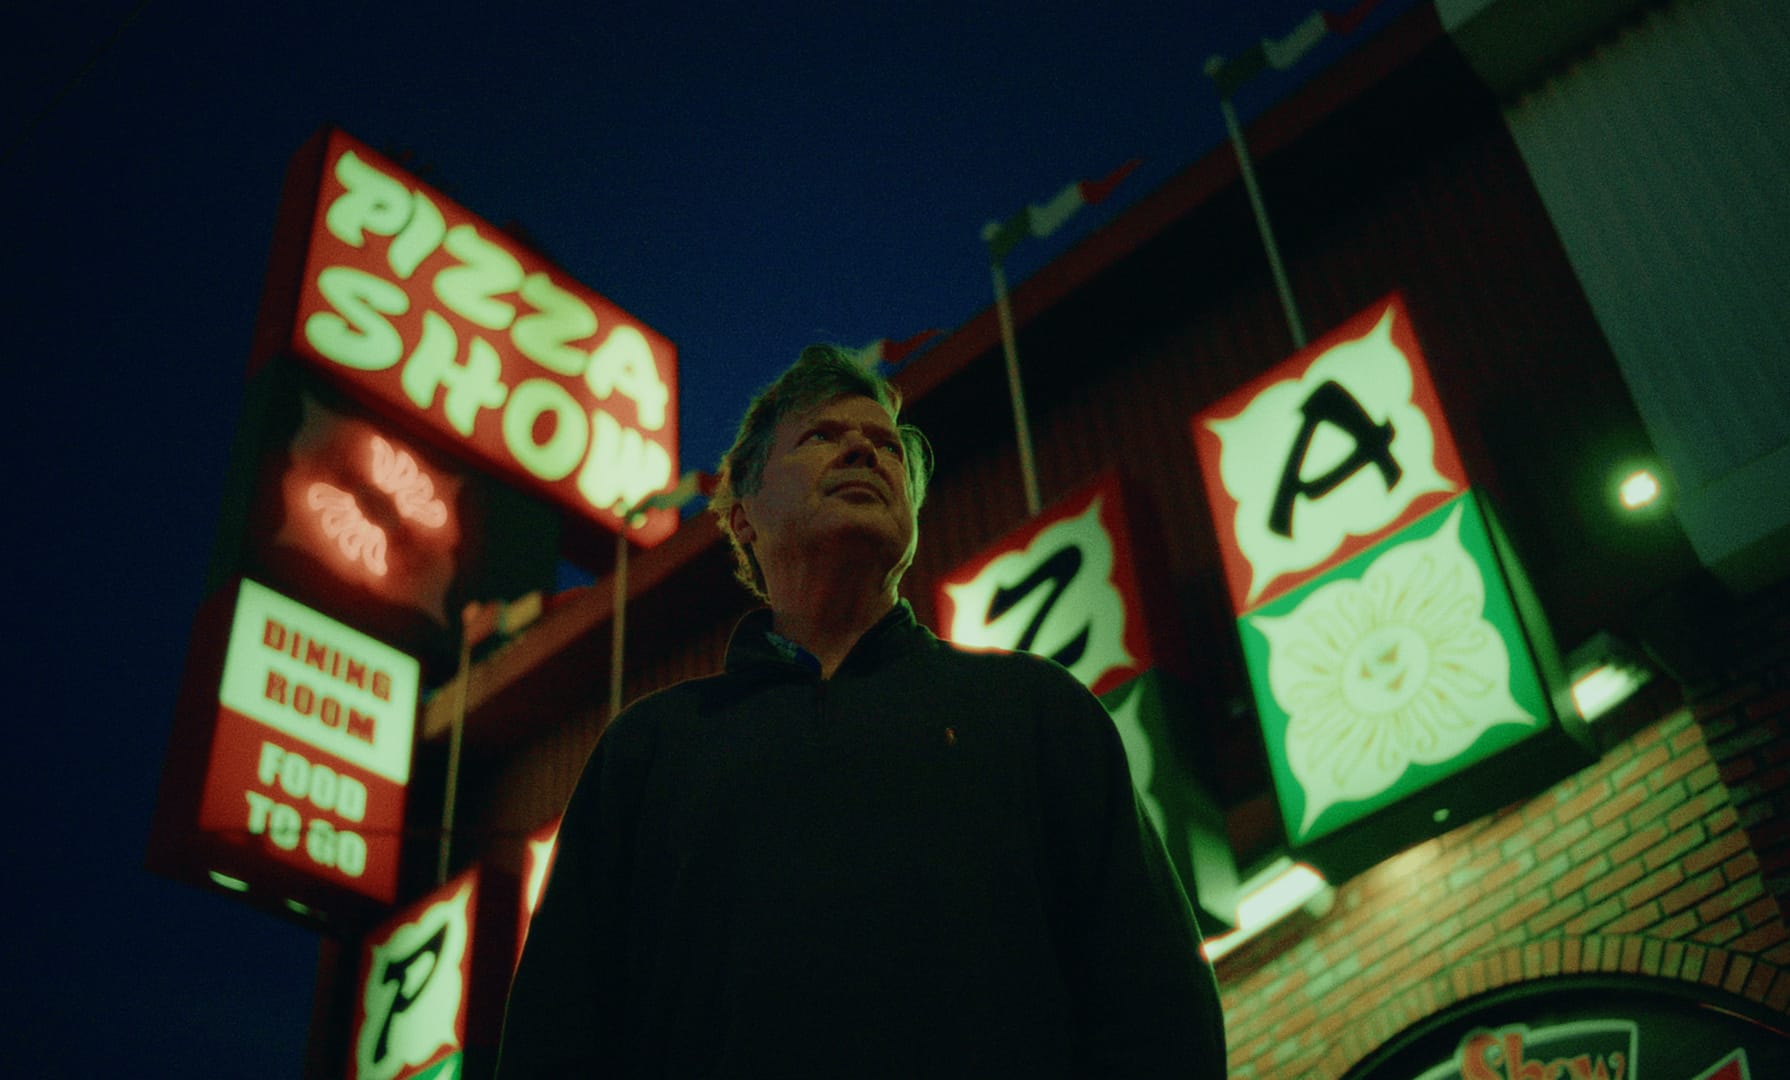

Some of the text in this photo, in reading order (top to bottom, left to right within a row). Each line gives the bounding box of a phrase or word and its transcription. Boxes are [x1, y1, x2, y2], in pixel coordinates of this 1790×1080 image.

[326, 150, 668, 431] PIZZA
[305, 266, 671, 511] SHOW
[1268, 380, 1403, 540] A
[263, 618, 392, 702] DINING
[264, 670, 376, 745] ROOM
[245, 789, 367, 878] TO GO
[257, 741, 367, 823] FOOD
[373, 922, 448, 1065] P
